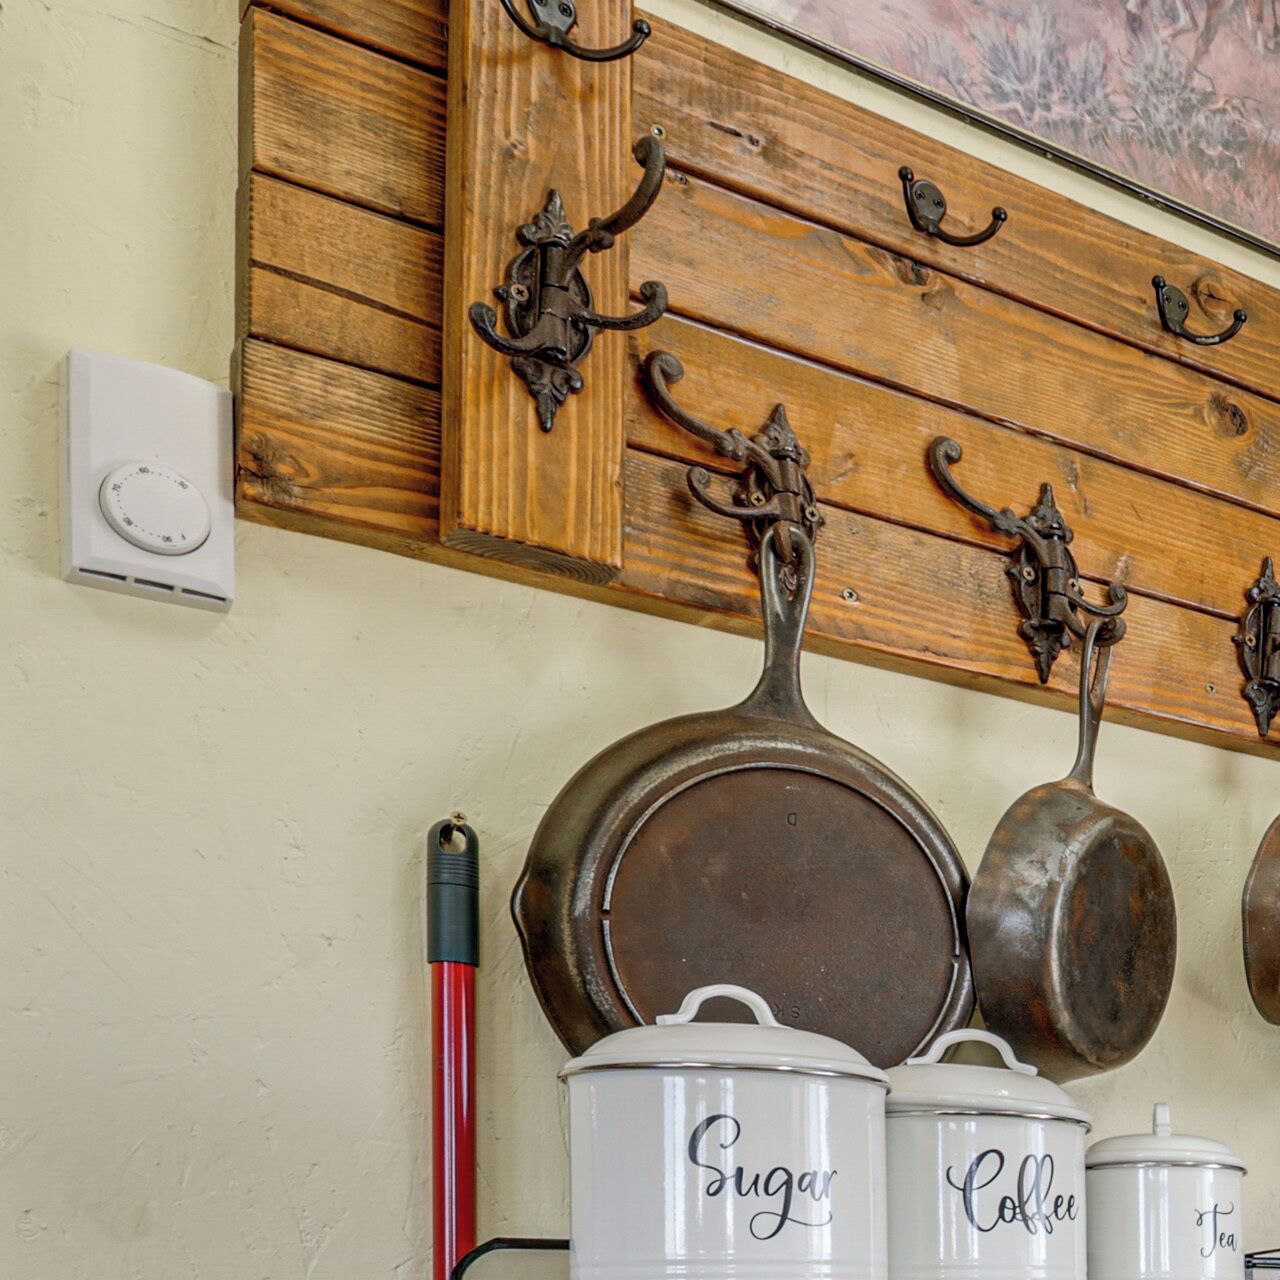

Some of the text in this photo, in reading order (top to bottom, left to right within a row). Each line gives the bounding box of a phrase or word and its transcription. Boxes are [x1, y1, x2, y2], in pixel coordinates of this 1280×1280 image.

[688, 1114, 838, 1241] Sugar
[946, 1149, 1079, 1235] Coffee
[1194, 1202, 1237, 1258] Tea
